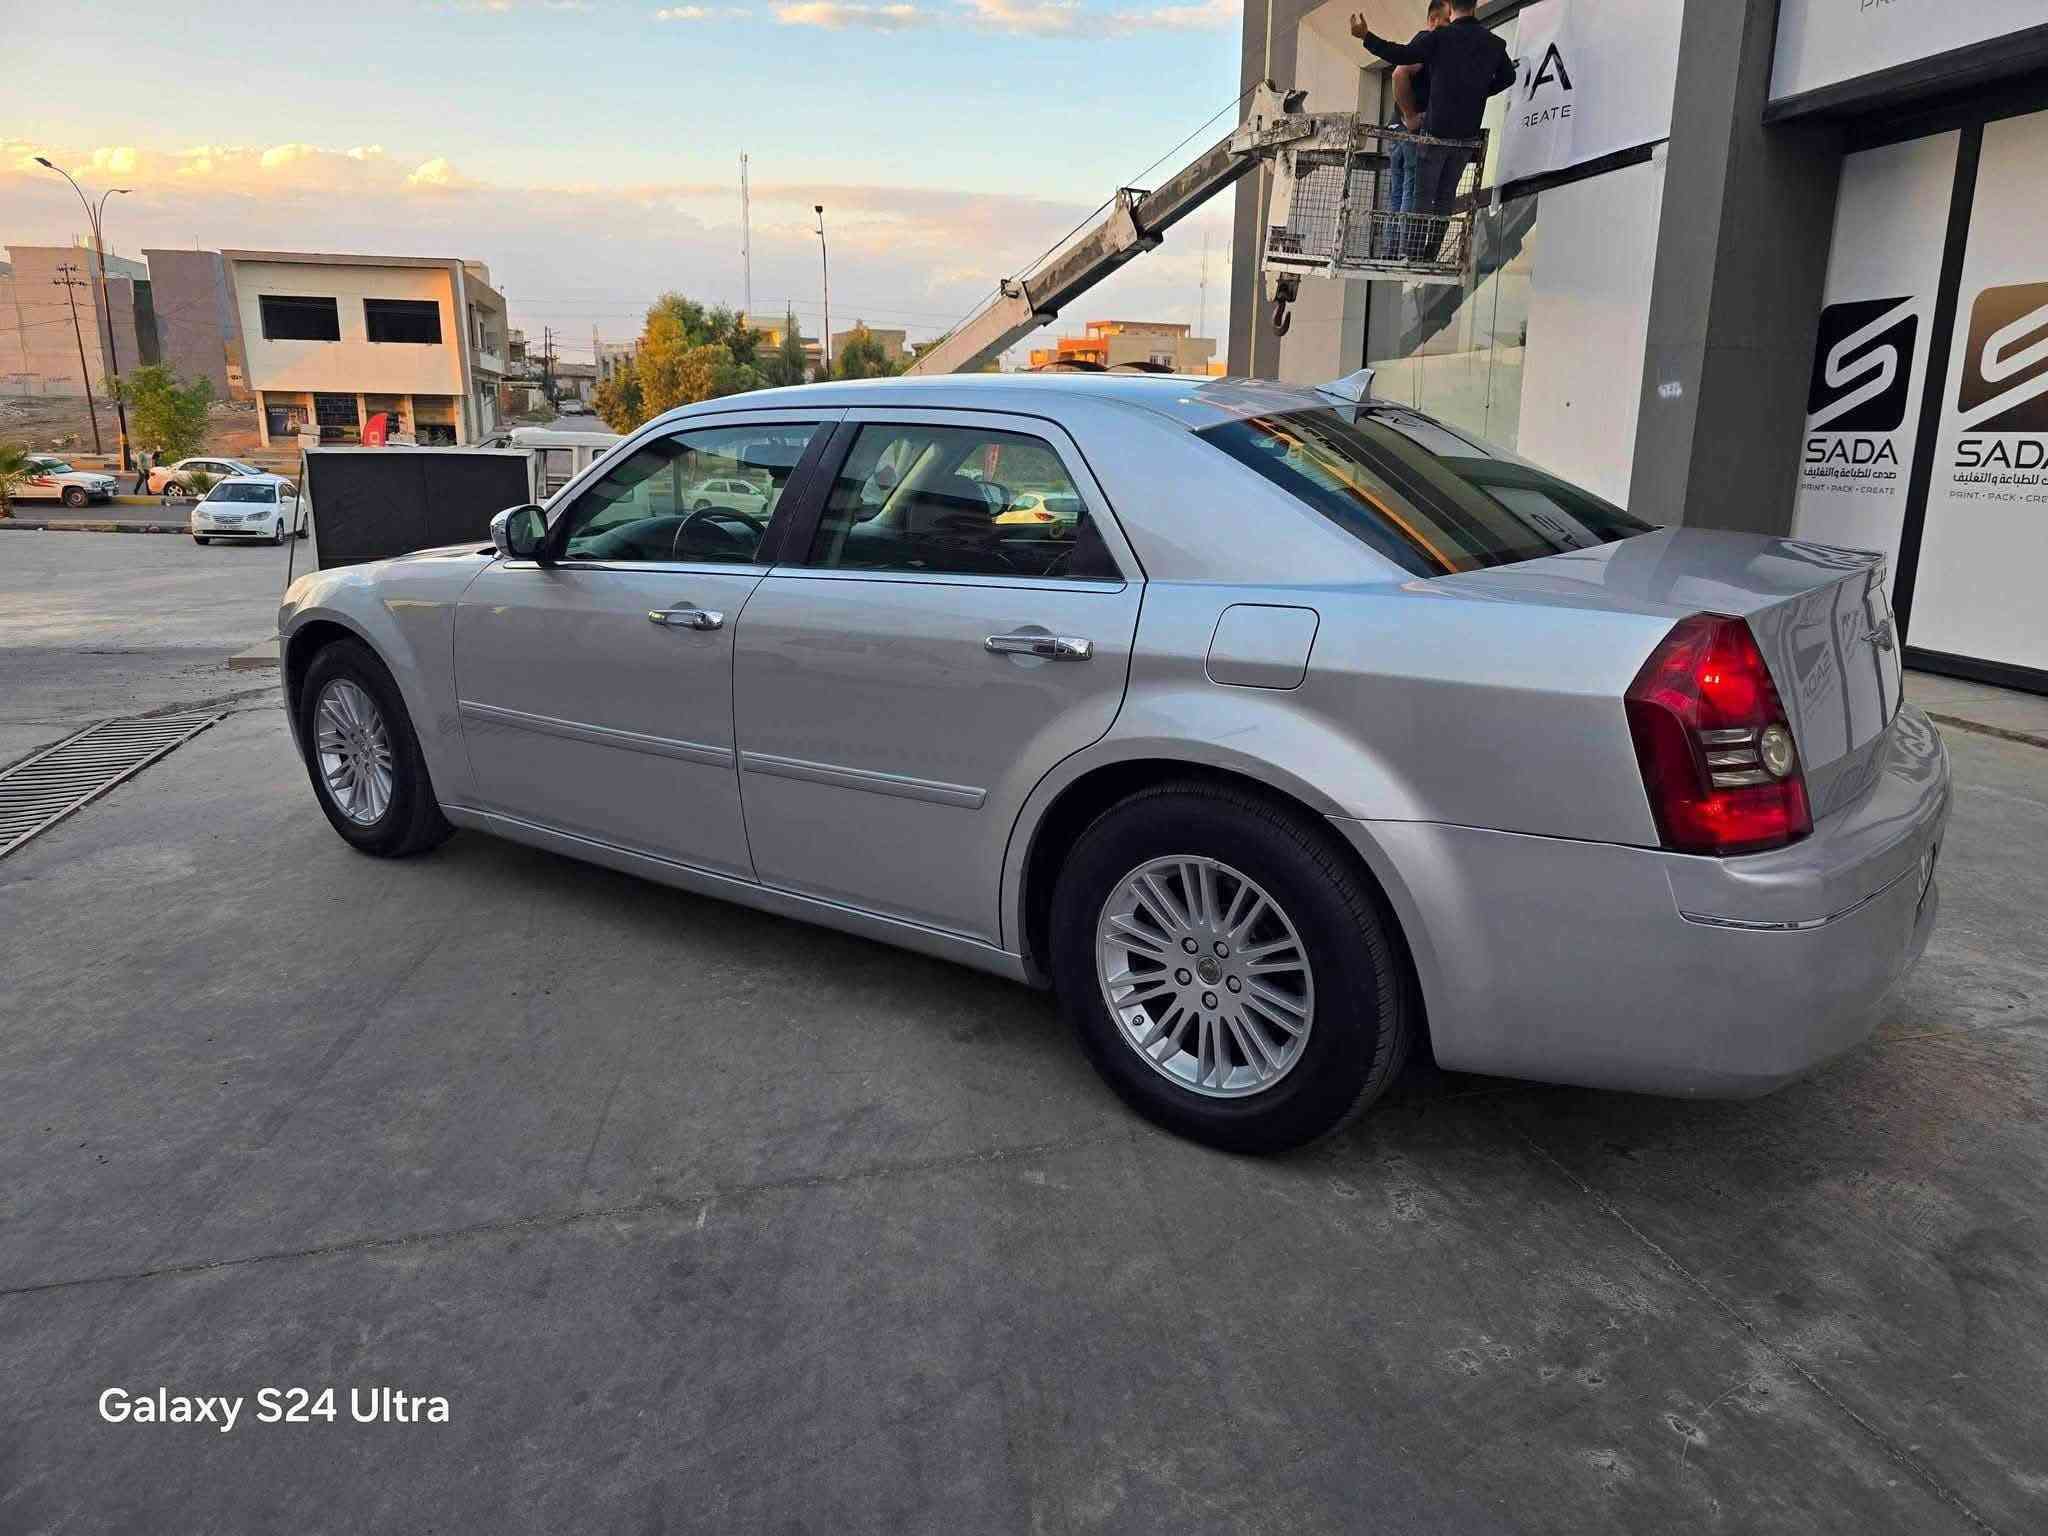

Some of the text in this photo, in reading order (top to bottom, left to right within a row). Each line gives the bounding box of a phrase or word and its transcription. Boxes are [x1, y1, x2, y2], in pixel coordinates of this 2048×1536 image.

[1521, 104, 1572, 128] REATE
[1805, 438, 1898, 465] SADA
[1999, 473, 2039, 488] للطباعة
